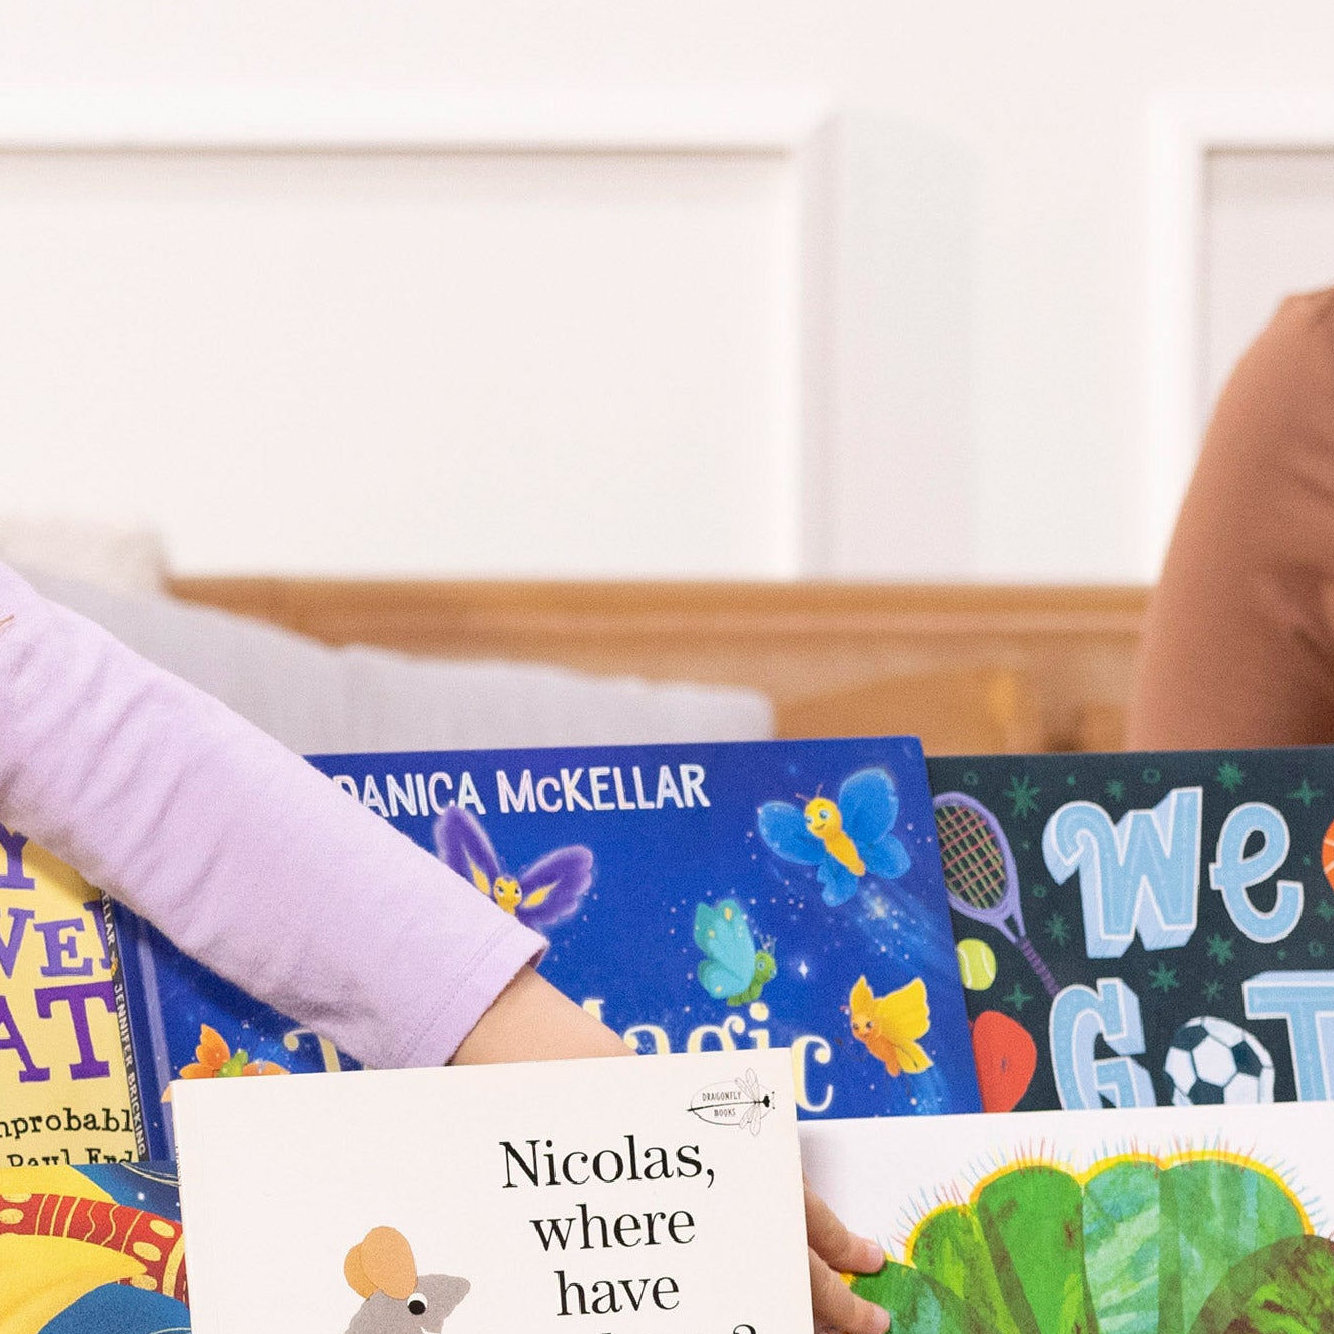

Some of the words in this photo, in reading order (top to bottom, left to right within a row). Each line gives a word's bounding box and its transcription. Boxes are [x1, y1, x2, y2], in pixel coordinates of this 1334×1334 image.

[100, 889, 115, 946] ELLAR
[114, 984, 133, 1067] JENNIFER
[127, 1074, 147, 1157] BRICKING
[702, 1091, 742, 1102] DRAGONFLY
[714, 1107, 736, 1118] BOOKS
[499, 1134, 716, 1189] Nicolas,
[529, 1203, 696, 1252] where
[554, 1270, 680, 1317] have
